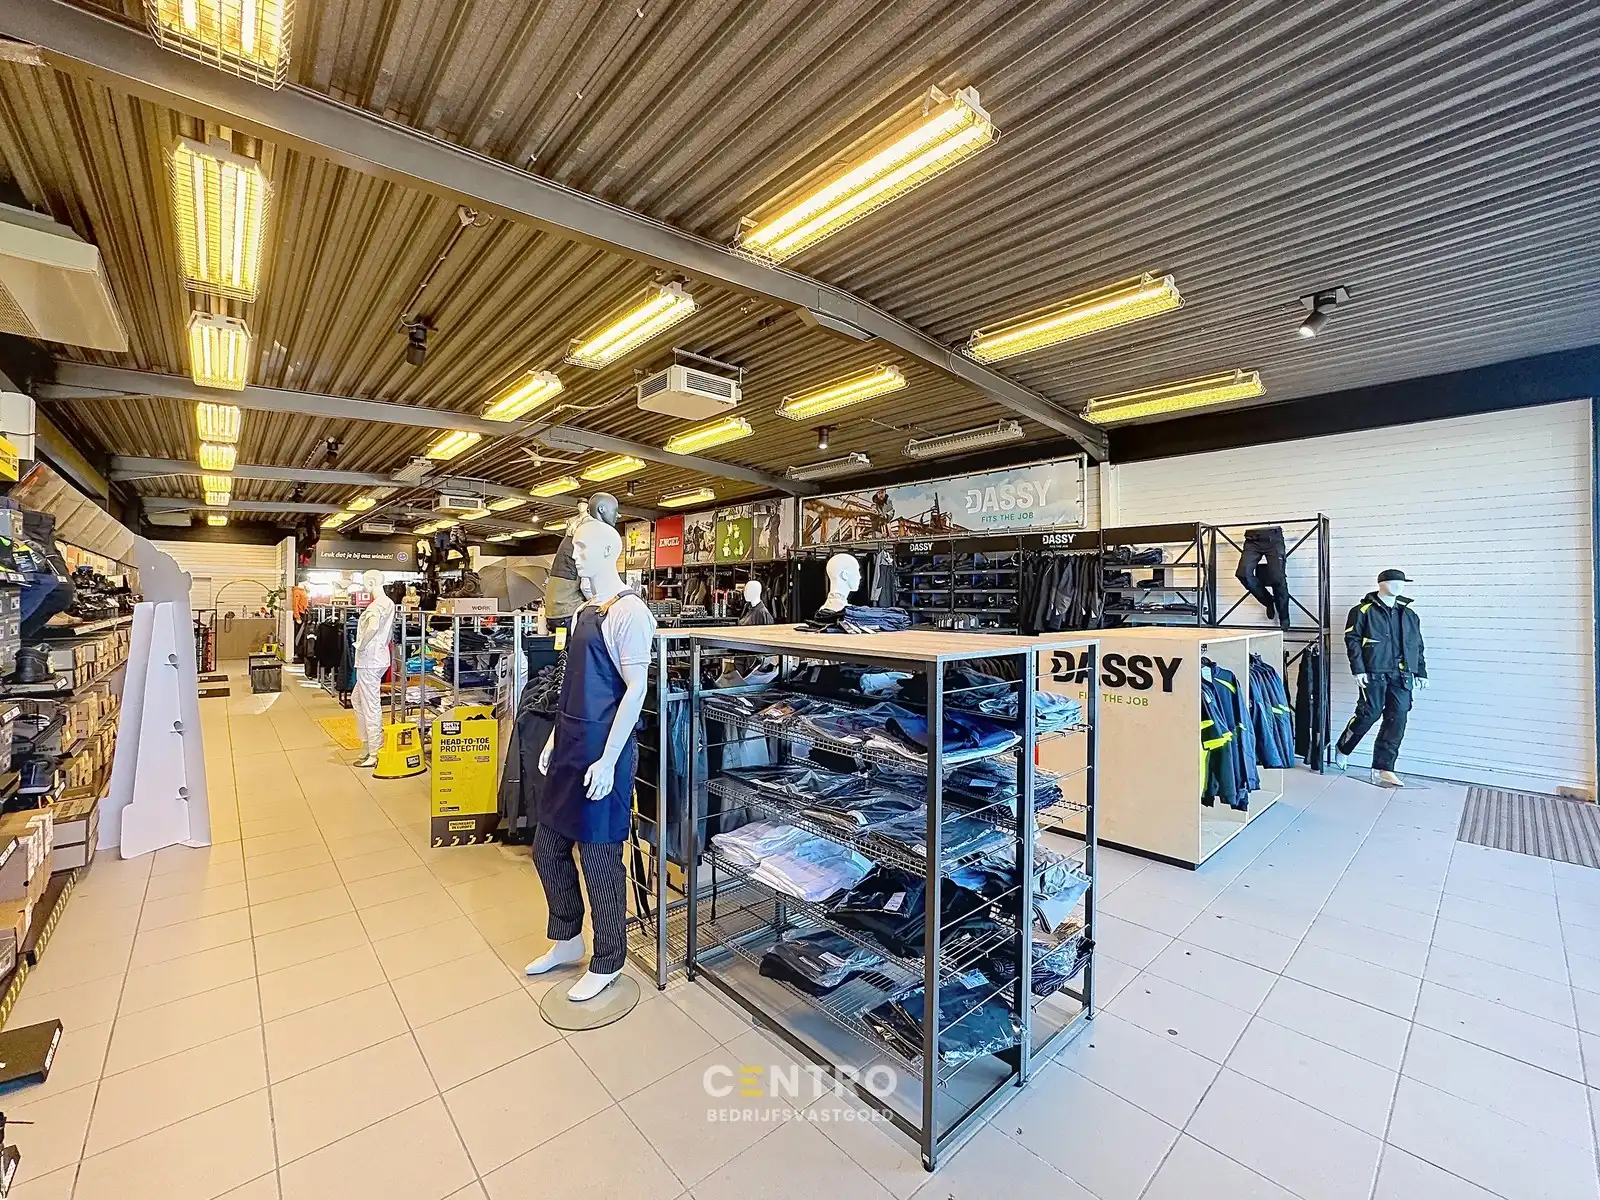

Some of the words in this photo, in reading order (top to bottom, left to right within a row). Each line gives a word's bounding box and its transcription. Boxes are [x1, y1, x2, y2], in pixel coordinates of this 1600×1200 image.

[965, 479, 1052, 514] DASSY
[981, 515, 998, 523] FITS
[1000, 513, 1015, 521] THE
[1017, 511, 1034, 520] JOB
[658, 536, 680, 548] ENGEL
[1042, 533, 1076, 545] DASSY
[909, 542, 934, 552] DASSY
[1102, 693, 1123, 704] THE
[1126, 696, 1149, 707] JOB
[440, 737, 490, 746] HEAD-TO-TOE
[440, 744, 490, 752] PROTECTION
